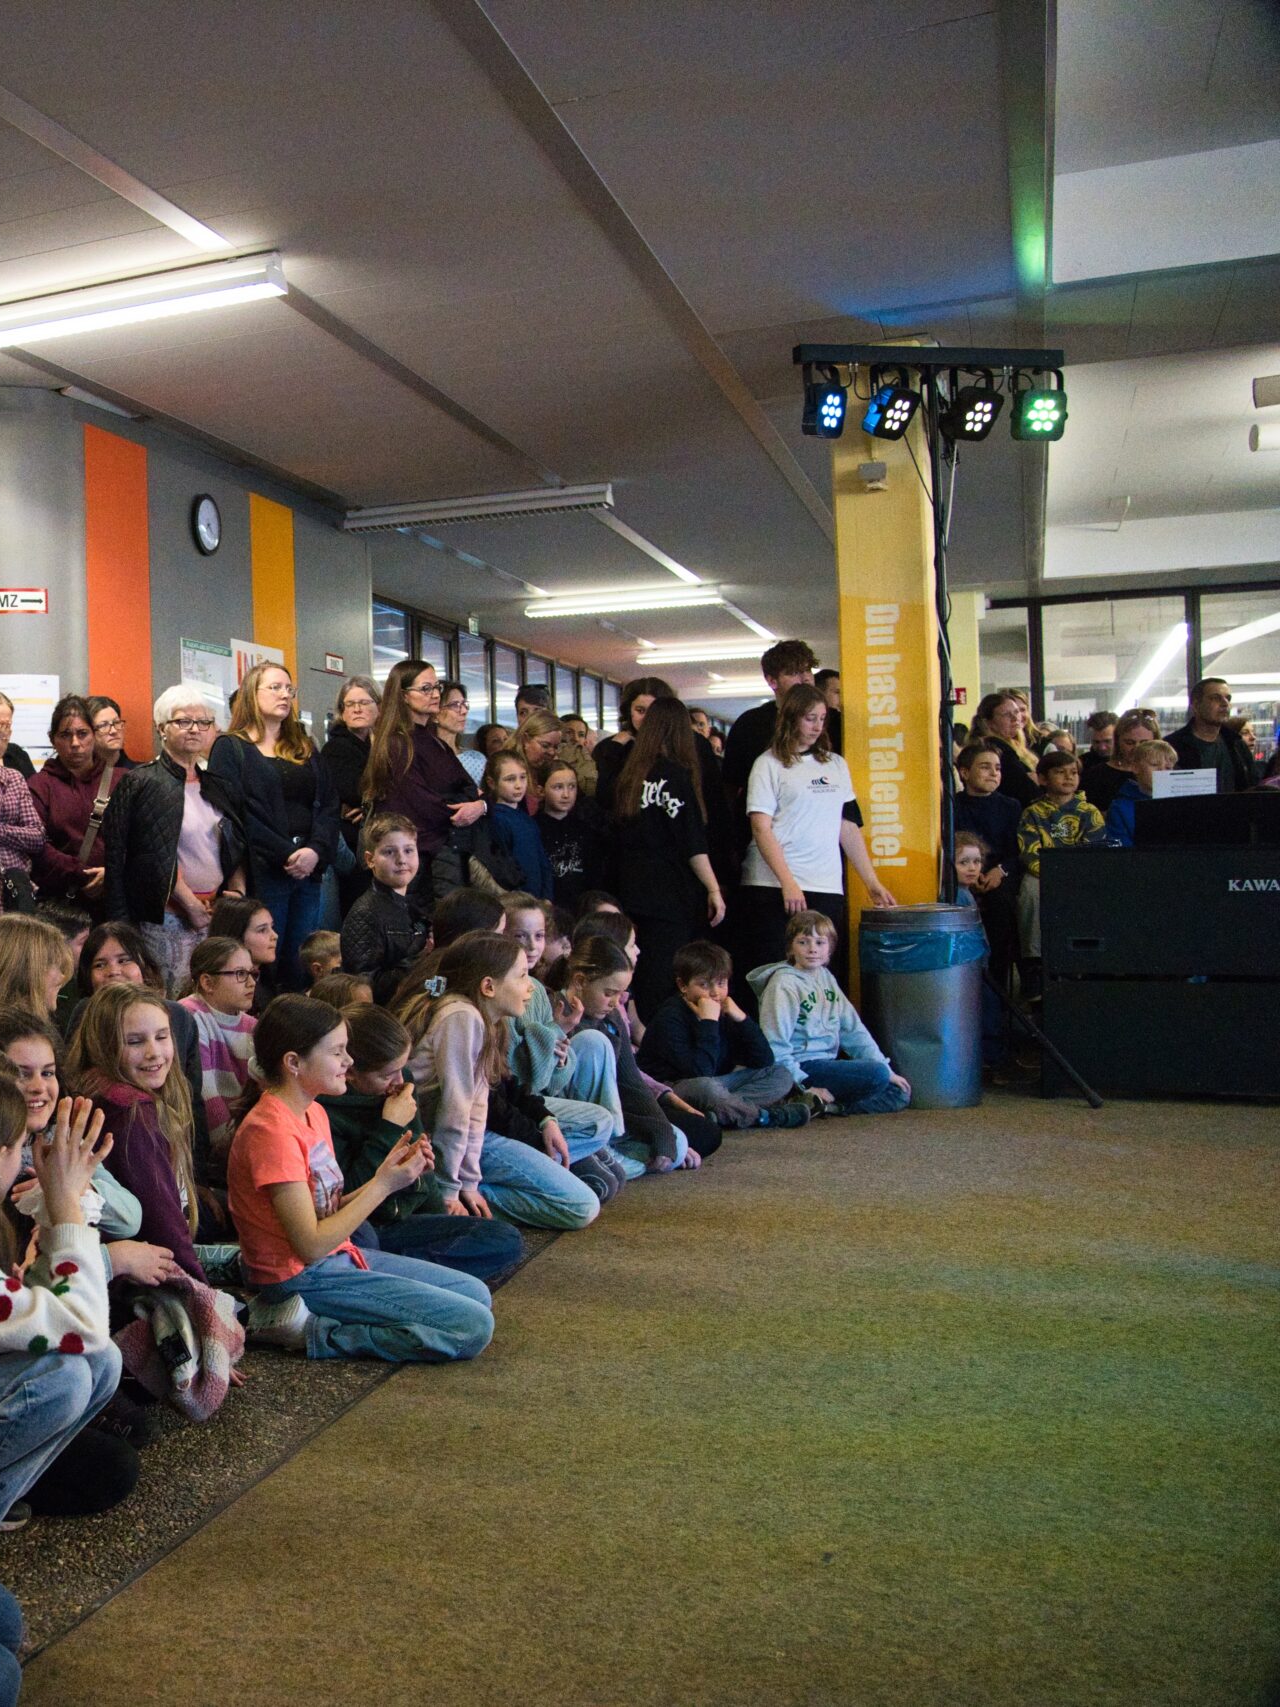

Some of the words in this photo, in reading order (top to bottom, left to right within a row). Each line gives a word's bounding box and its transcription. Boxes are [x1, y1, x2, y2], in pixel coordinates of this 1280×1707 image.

[864, 603, 900, 646] Du
[866, 653, 902, 728] hast
[868, 731, 908, 868] Talente!
